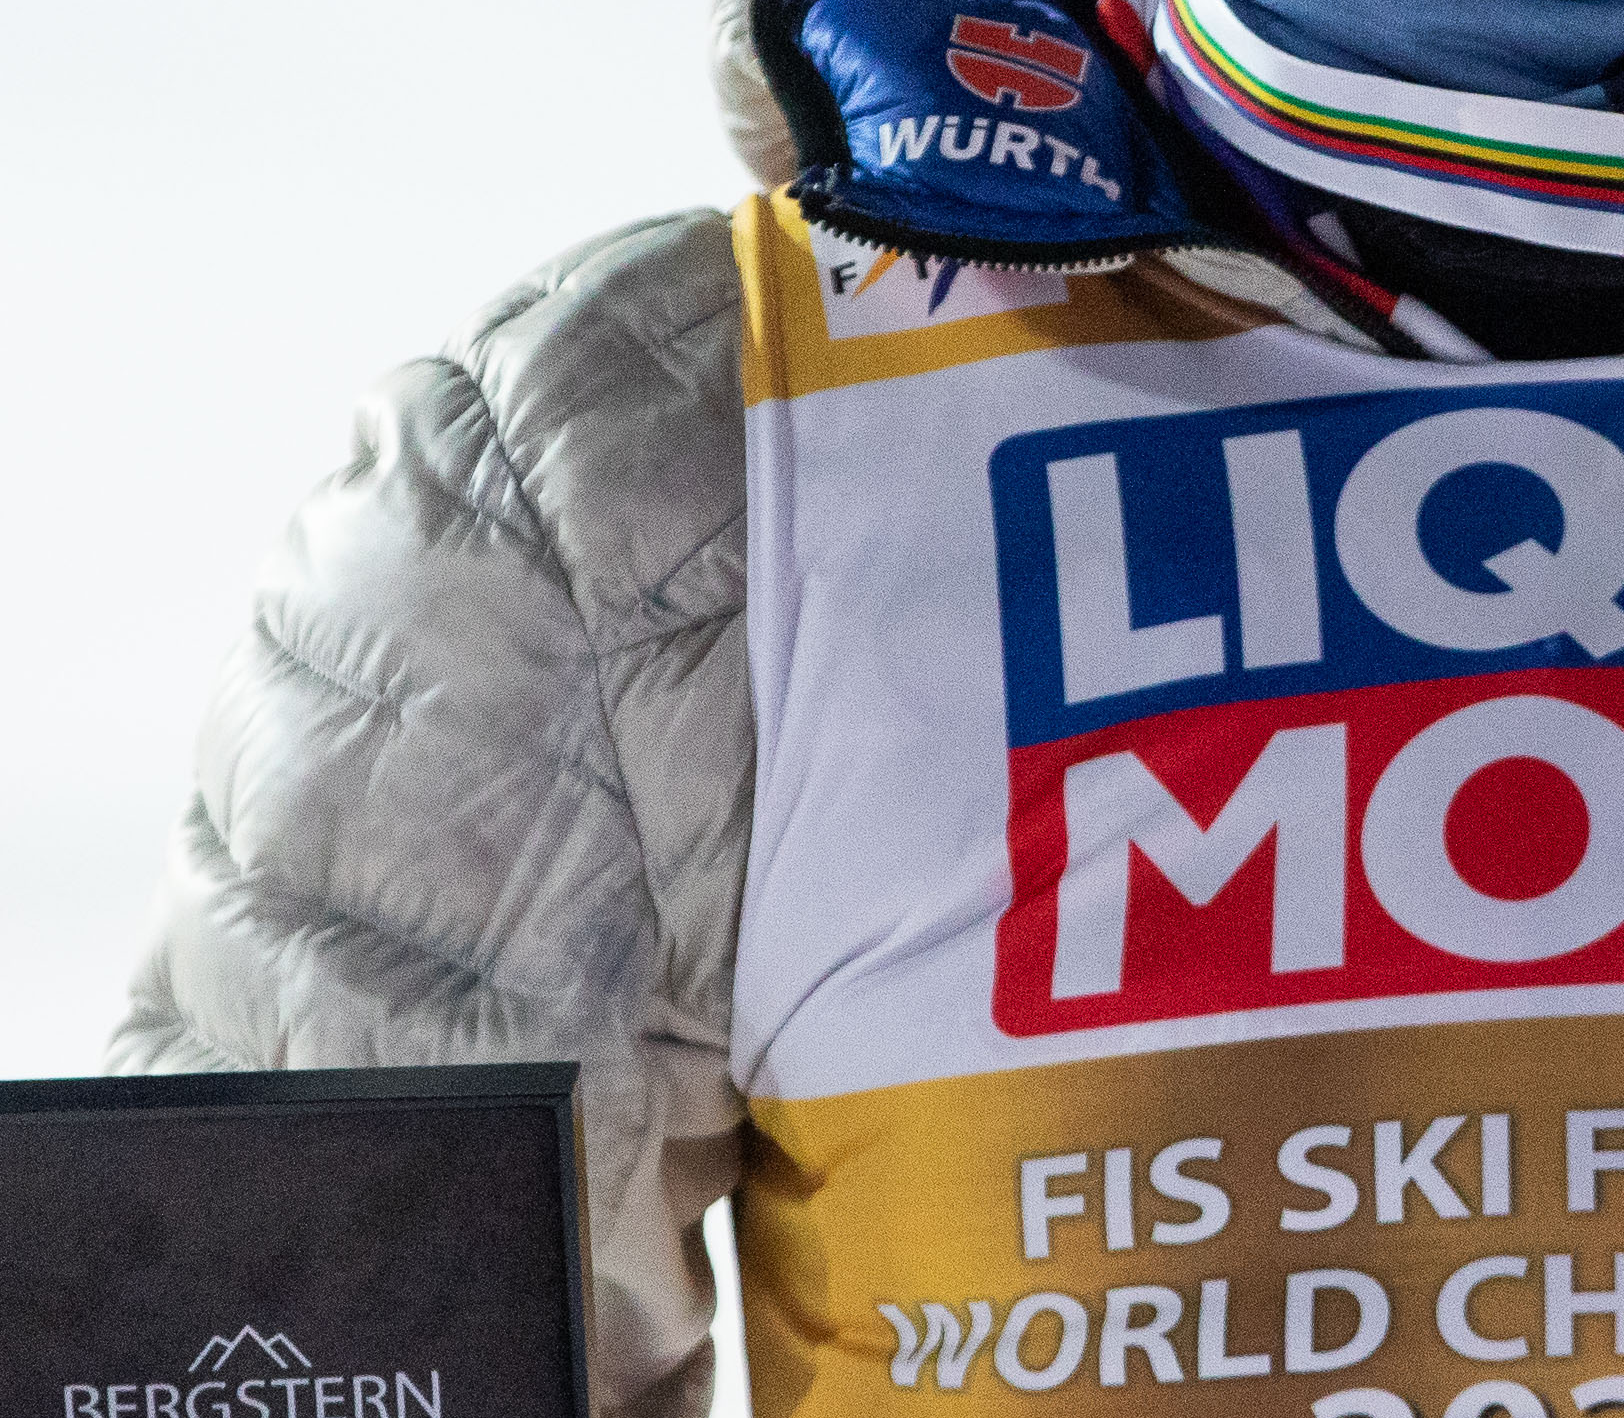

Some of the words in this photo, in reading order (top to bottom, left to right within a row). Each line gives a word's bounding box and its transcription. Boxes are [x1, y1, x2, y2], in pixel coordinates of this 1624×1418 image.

[1019, 1135, 1232, 1260] FIS
[1276, 1112, 1514, 1234] SKI
[877, 1267, 1392, 1394] WORLD
